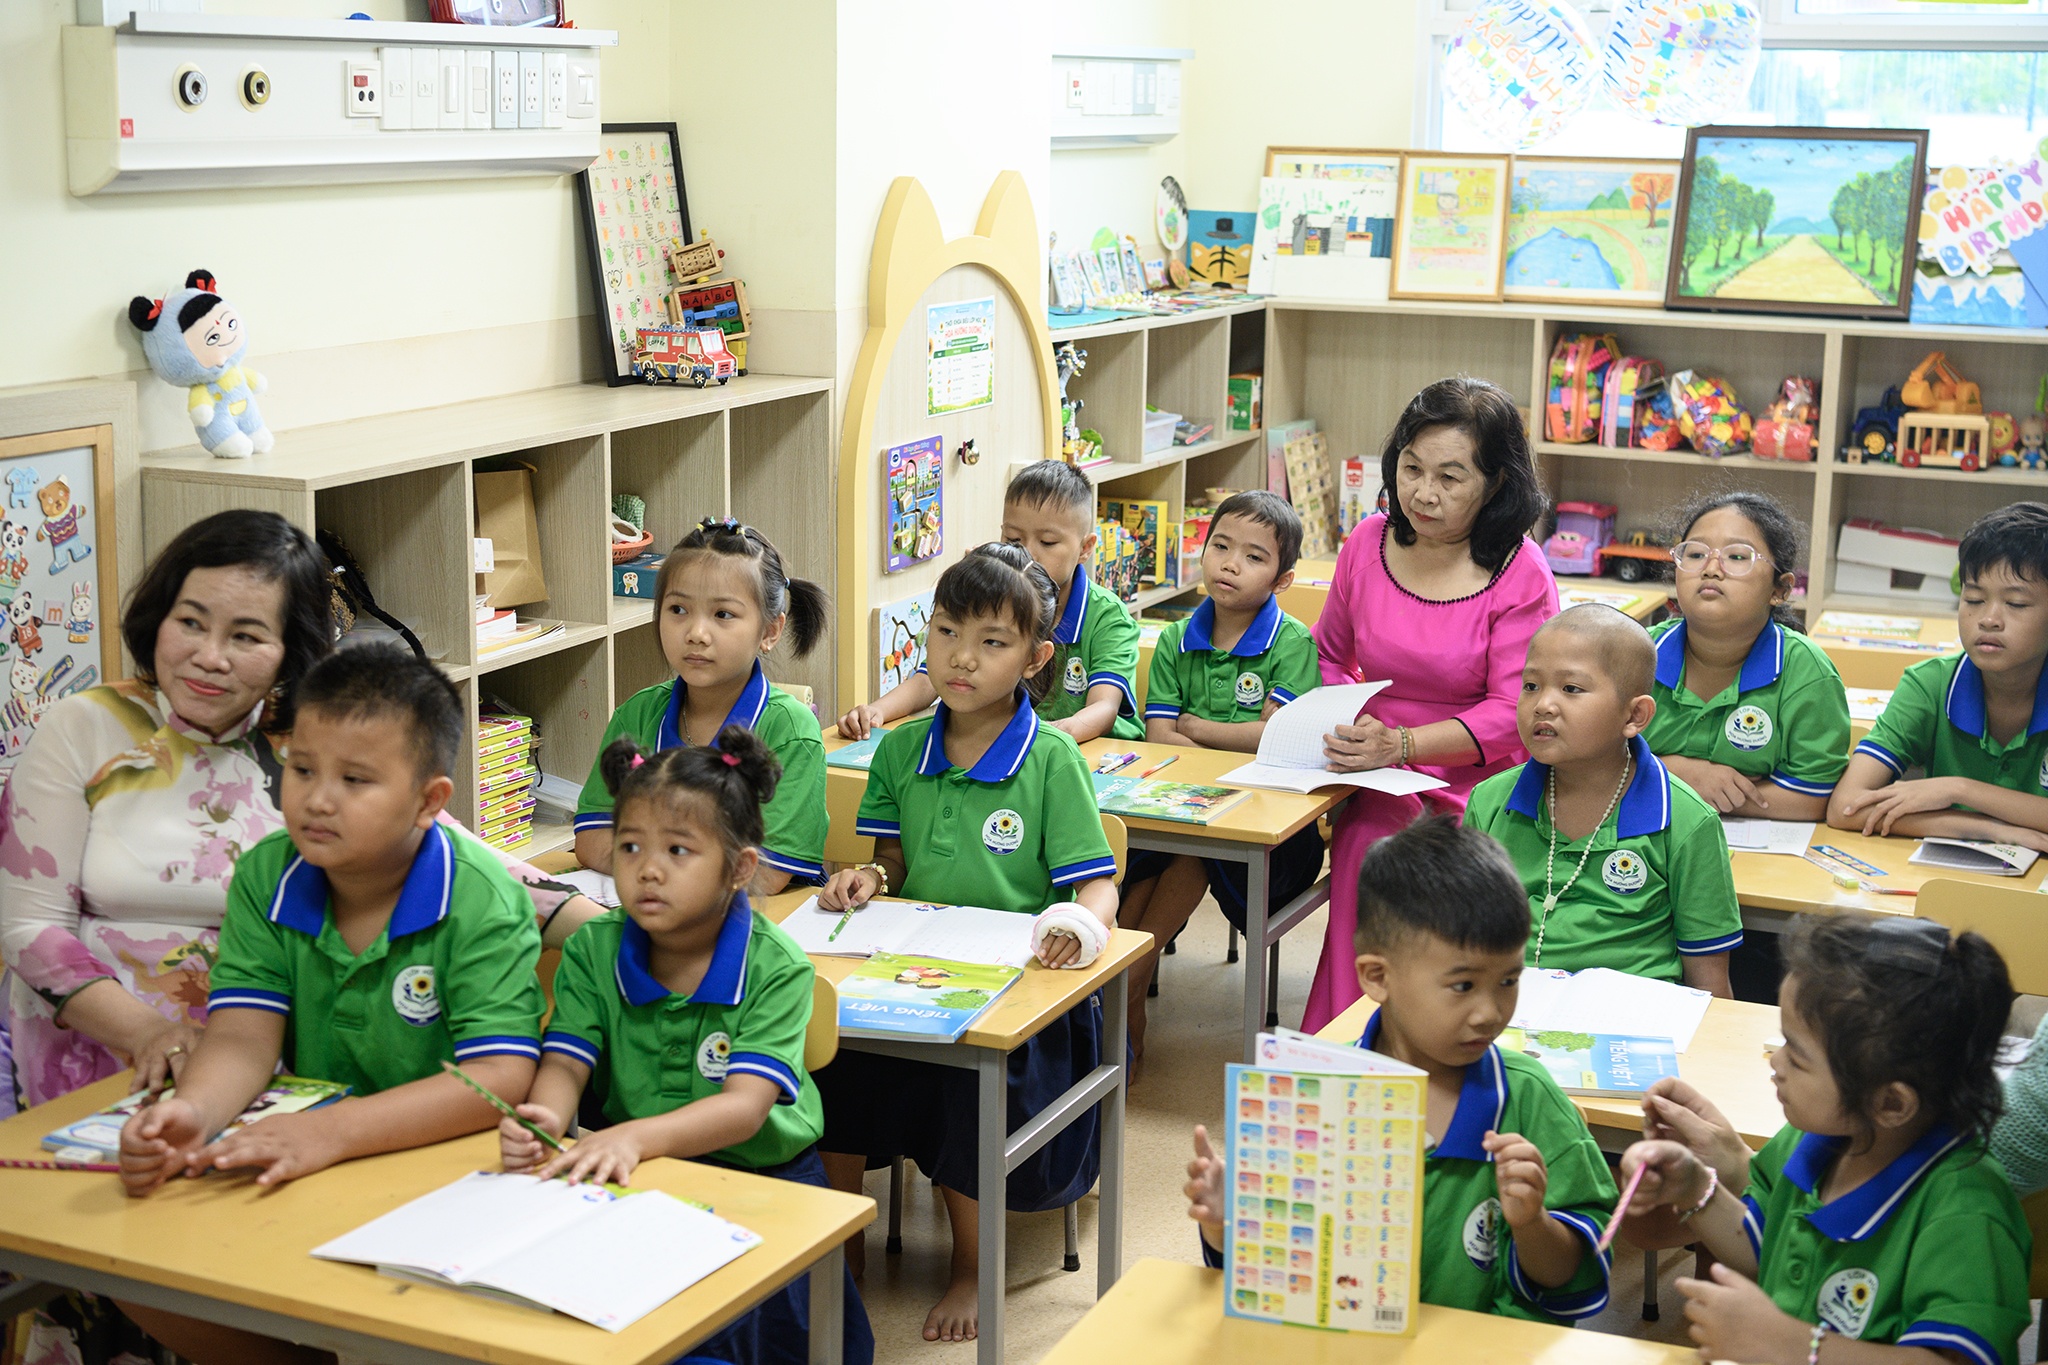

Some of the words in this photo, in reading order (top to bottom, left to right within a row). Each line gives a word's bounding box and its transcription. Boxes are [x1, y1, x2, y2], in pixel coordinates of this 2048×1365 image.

[1475, 18, 1562, 102] HAPPY
[1622, 6, 1668, 112] HAPPY
[1944, 160, 2042, 232] HAPPY
[48, 607, 62, 622] m
[22, 626, 32, 640] 18
[845, 1002, 890, 1012] VIỆT
[892, 1005, 952, 1020] TIẾNG
[1609, 1040, 1629, 1064] TIẾNG
[1608, 1064, 1634, 1080] VIỆT
[1383, 1154, 1392, 1169] Qu
[1377, 1264, 1386, 1284] Ngh
[1377, 1286, 1386, 1306] ngh
